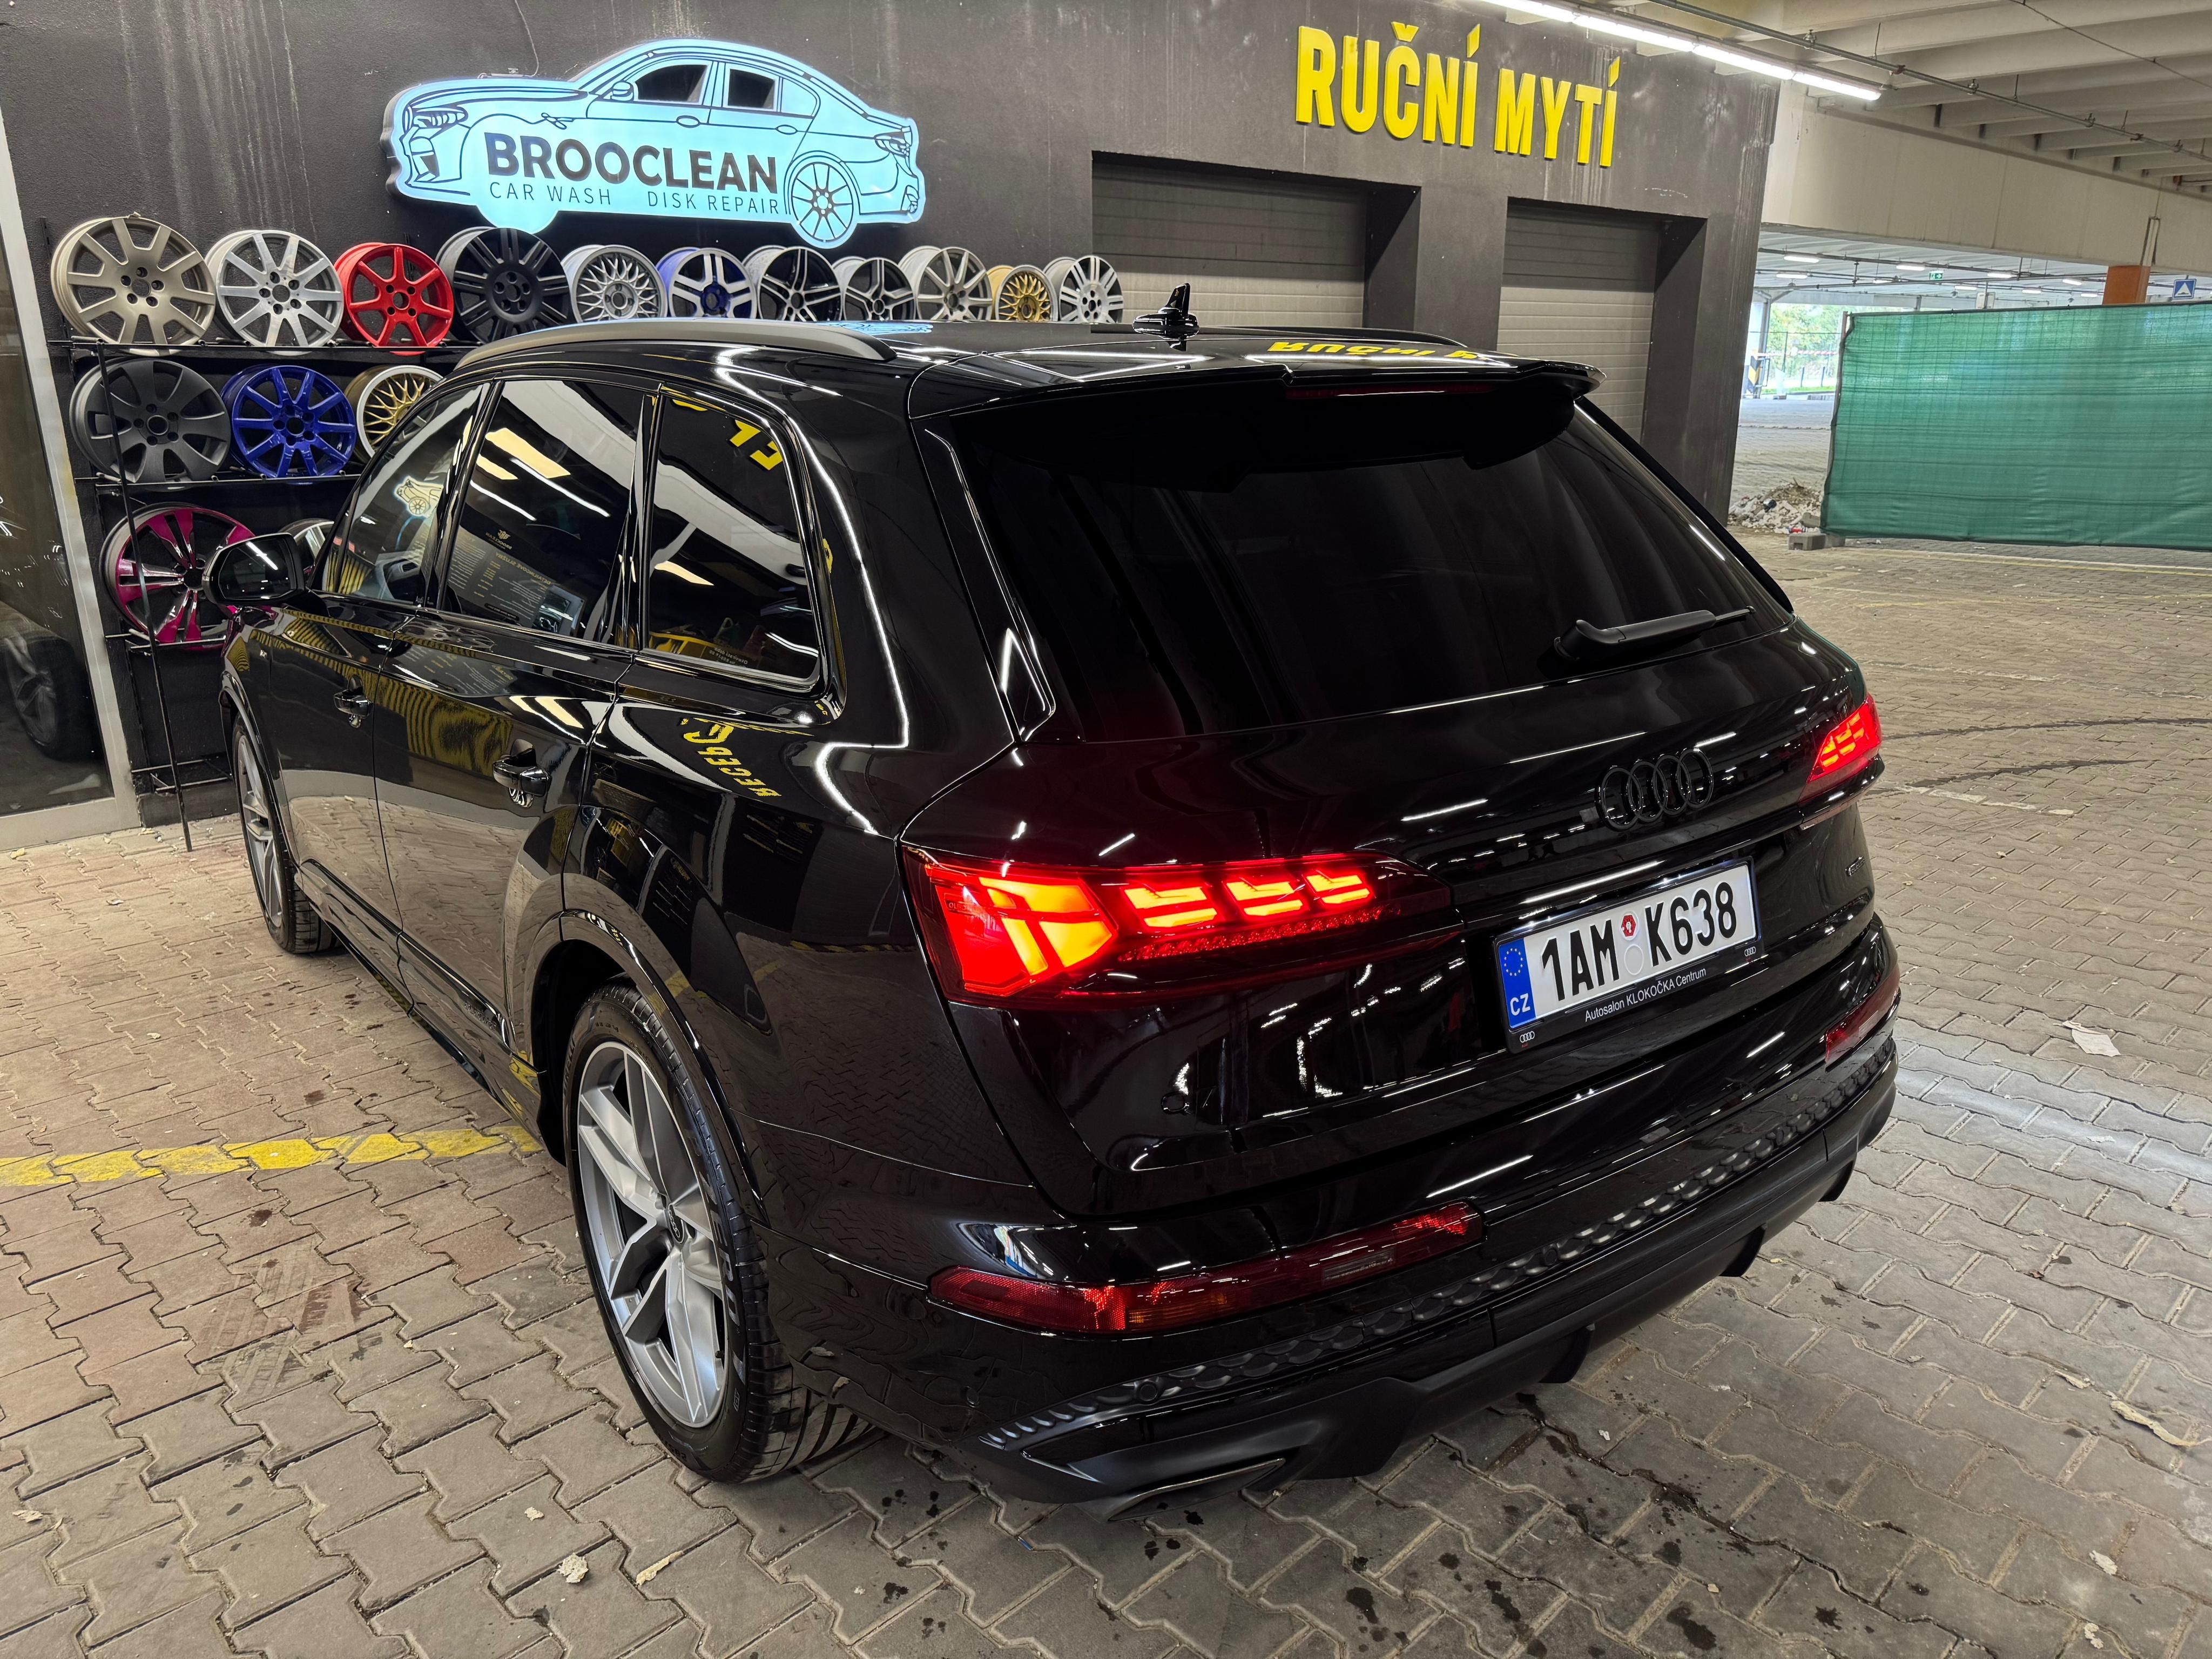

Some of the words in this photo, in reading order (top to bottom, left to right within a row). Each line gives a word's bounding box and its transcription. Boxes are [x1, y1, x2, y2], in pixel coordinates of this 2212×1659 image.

[1296, 21, 1480, 147] RUČNÍ
[1494, 56, 1620, 167] MYTÍ
[484, 132, 778, 194] BROOCLEAN
[489, 181, 535, 200] CAR
[548, 185, 611, 205] WASH
[648, 191, 697, 210] DISK
[709, 194, 779, 214] REPAIR
[1541, 919, 1620, 1001] 1AM
[1644, 881, 1737, 967] K638
[1510, 993, 1531, 1016] CZ
[1584, 999, 1625, 1022] Autosalon
[1627, 977, 1675, 1007] KLOKOČKA
[1676, 967, 1707, 987] Centrum
